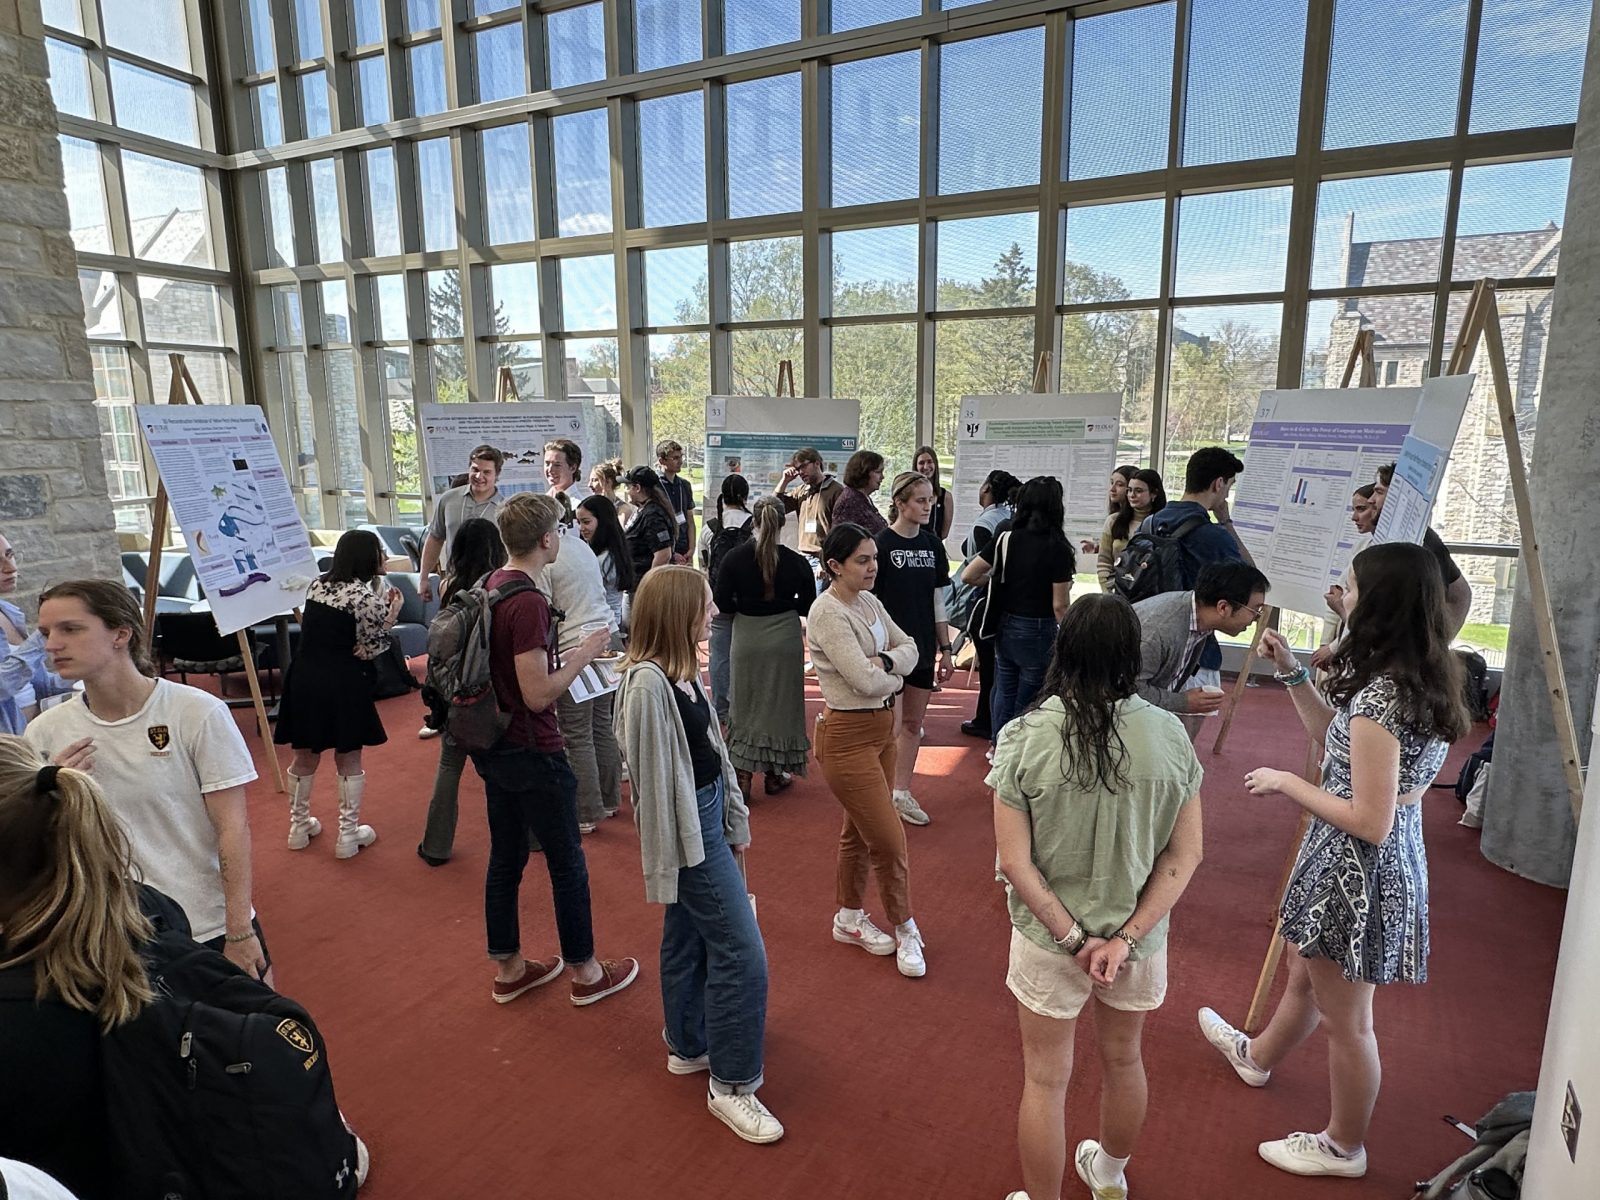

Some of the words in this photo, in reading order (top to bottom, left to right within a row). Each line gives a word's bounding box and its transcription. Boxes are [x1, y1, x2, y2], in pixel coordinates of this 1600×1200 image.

[964, 410, 974, 418] 35
[1259, 408, 1270, 418] 37
[907, 558, 935, 568] INCLUDE
